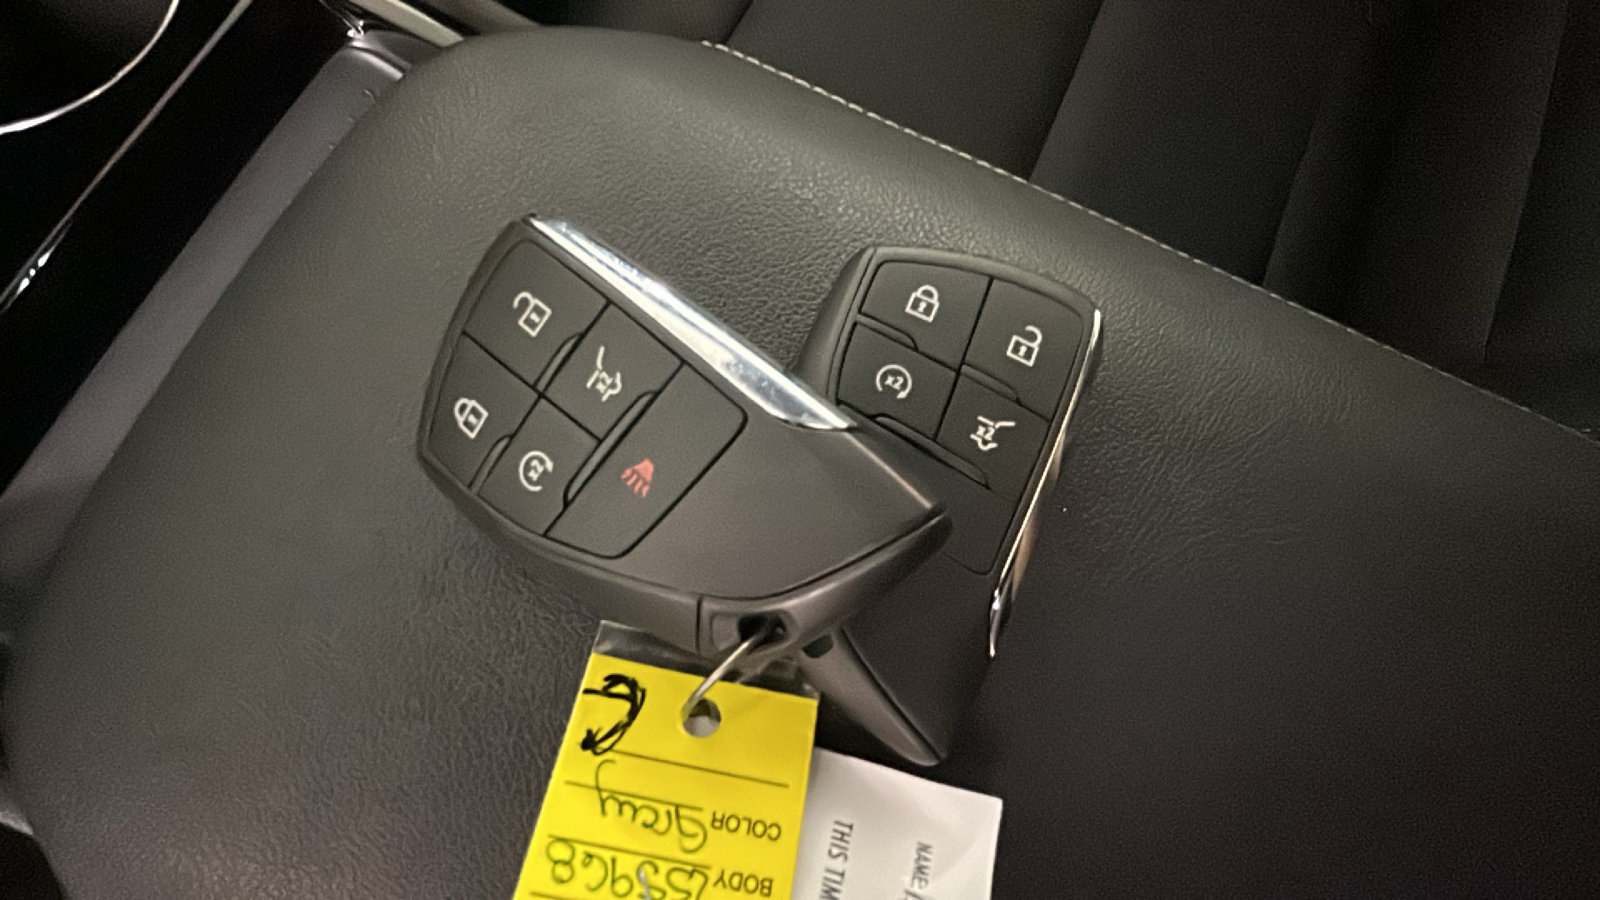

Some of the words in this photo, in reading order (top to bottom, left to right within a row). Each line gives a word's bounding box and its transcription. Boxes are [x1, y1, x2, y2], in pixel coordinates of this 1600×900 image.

[884, 374, 904, 390] x2
[976, 425, 995, 441] x2
[711, 811, 782, 841] COLOR
[827, 820, 855, 863] THIS
[713, 868, 775, 898] BODY
